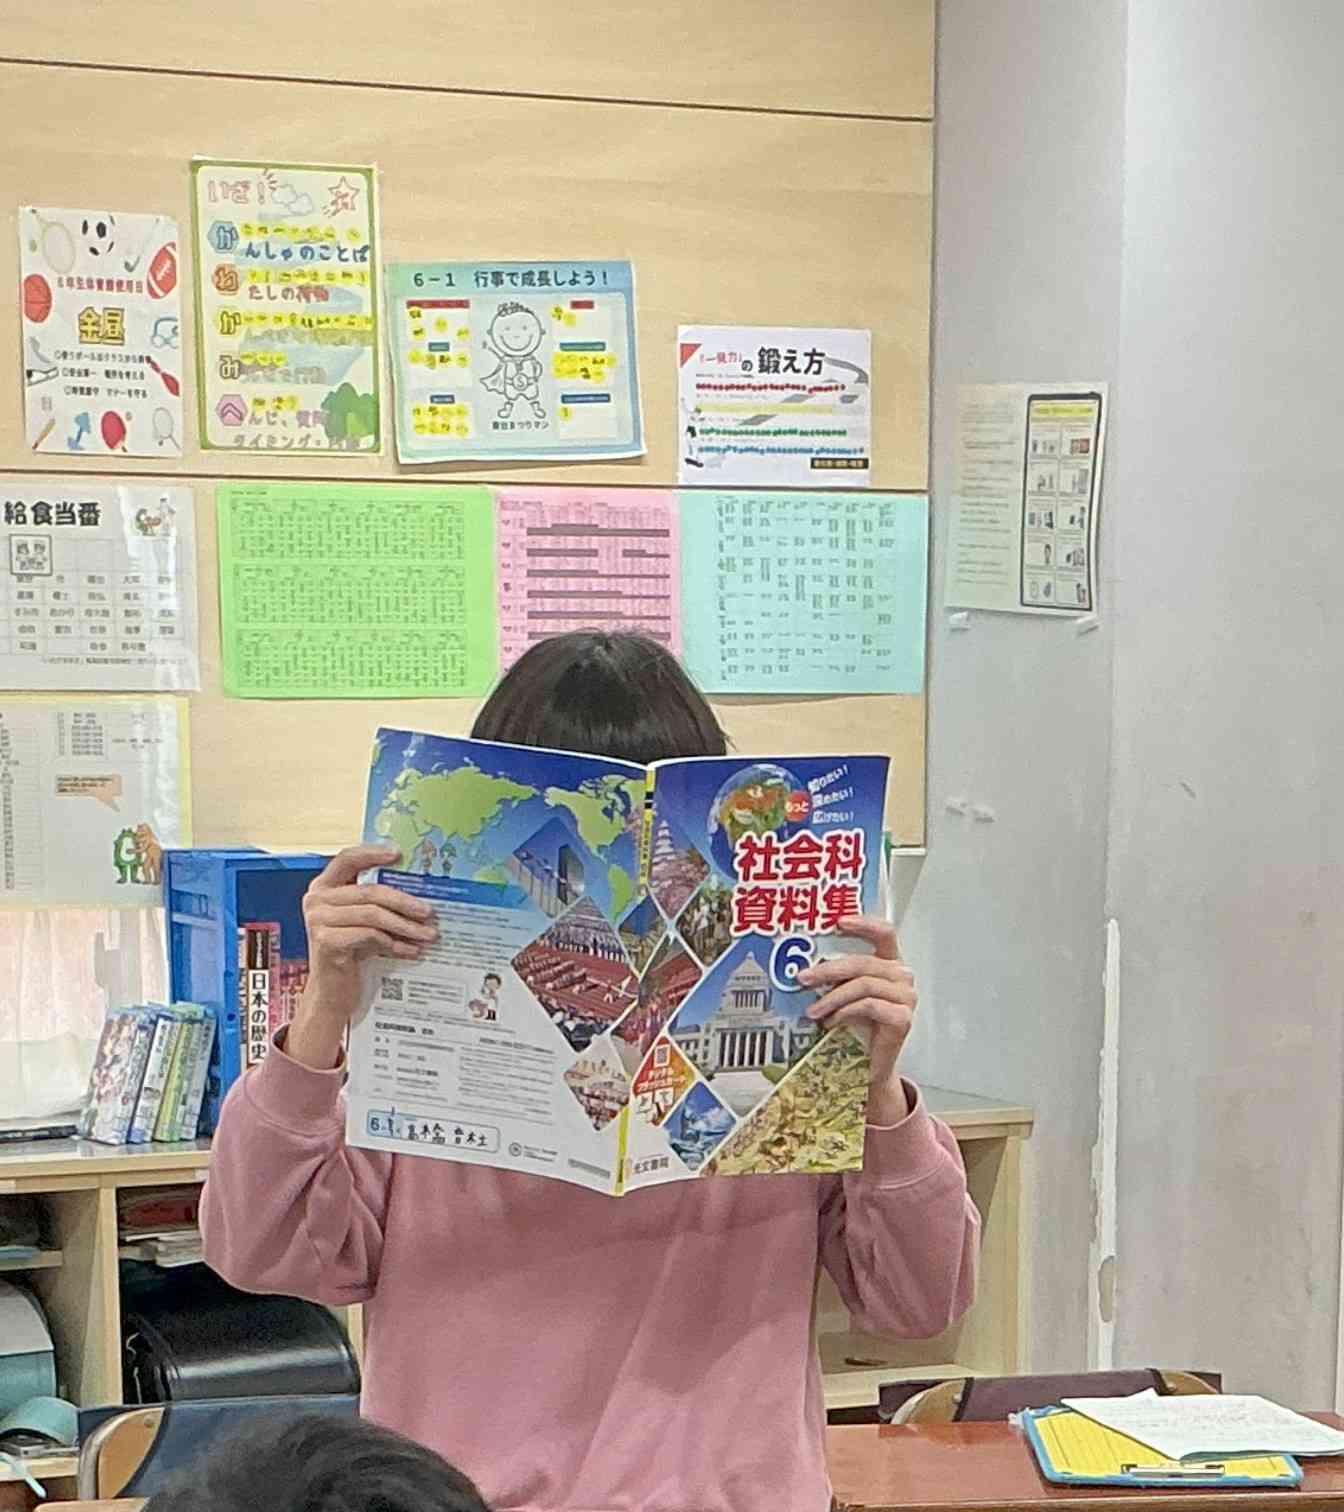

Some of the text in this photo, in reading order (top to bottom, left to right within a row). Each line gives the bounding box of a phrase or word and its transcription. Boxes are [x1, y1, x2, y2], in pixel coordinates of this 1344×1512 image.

[757, 346, 827, 376] 鍛え方
[3, 501, 102, 527] 給食当番
[736, 832, 864, 882] 社会科
[734, 883, 863, 932] 資料集
[773, 937, 817, 990] 6
[251, 972, 268, 1060] 日本の歴史
